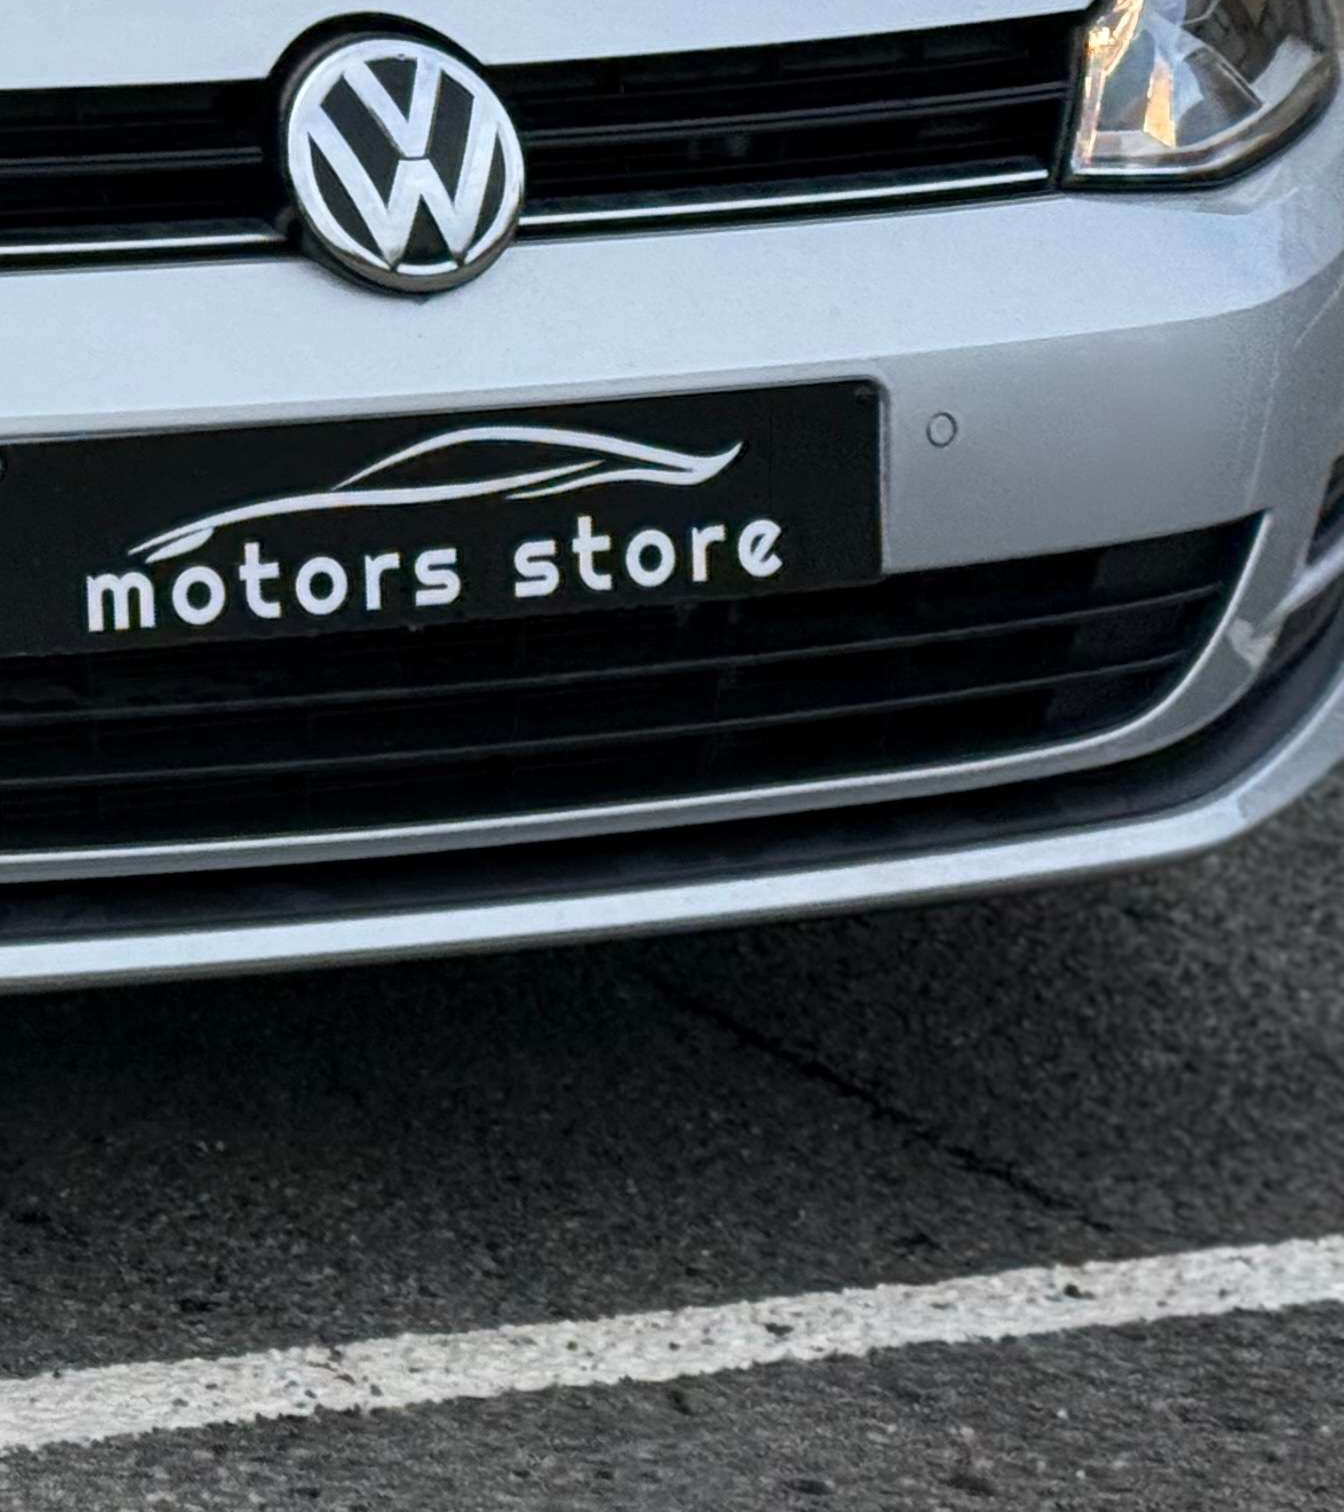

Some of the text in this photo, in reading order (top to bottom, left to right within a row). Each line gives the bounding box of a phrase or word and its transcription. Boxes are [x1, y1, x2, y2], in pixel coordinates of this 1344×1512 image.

[291, 41, 522, 274] VW
[85, 515, 784, 633] motors store
